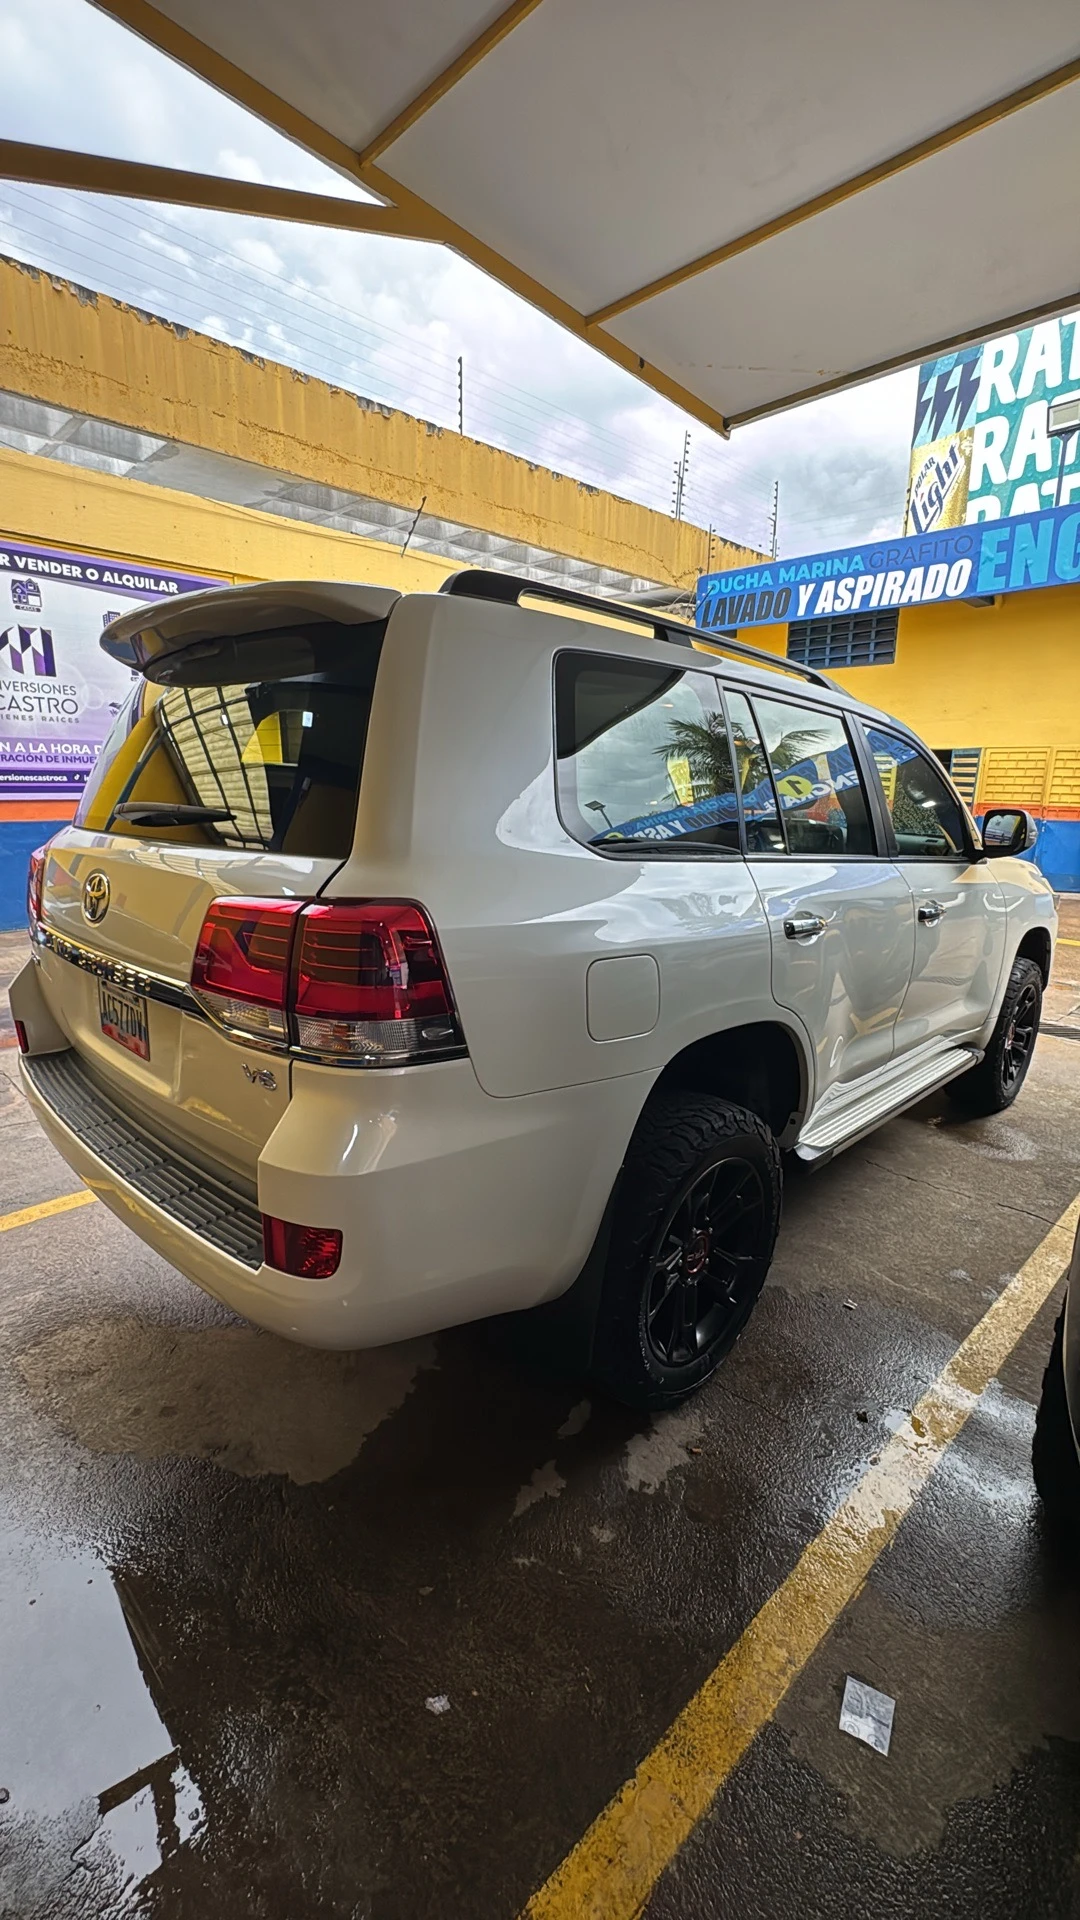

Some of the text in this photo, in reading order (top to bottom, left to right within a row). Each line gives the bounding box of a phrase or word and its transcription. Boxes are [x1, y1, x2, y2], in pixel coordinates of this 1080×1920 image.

[910, 443, 959, 534] Light
[14, 555, 83, 579] VENDER
[86, 568, 100, 581] O
[103, 571, 179, 594] ALQUILAR
[707, 535, 974, 597] DUCHA MARINA GRAFITO
[701, 558, 973, 629] LAVADO Y ASPIRADO
[41, 714, 80, 724] RAÍCES
[14, 742, 26, 753] A
[28, 742, 48, 753] LA
[50, 743, 91, 754] HORA
[45, 754, 60, 764] DE
